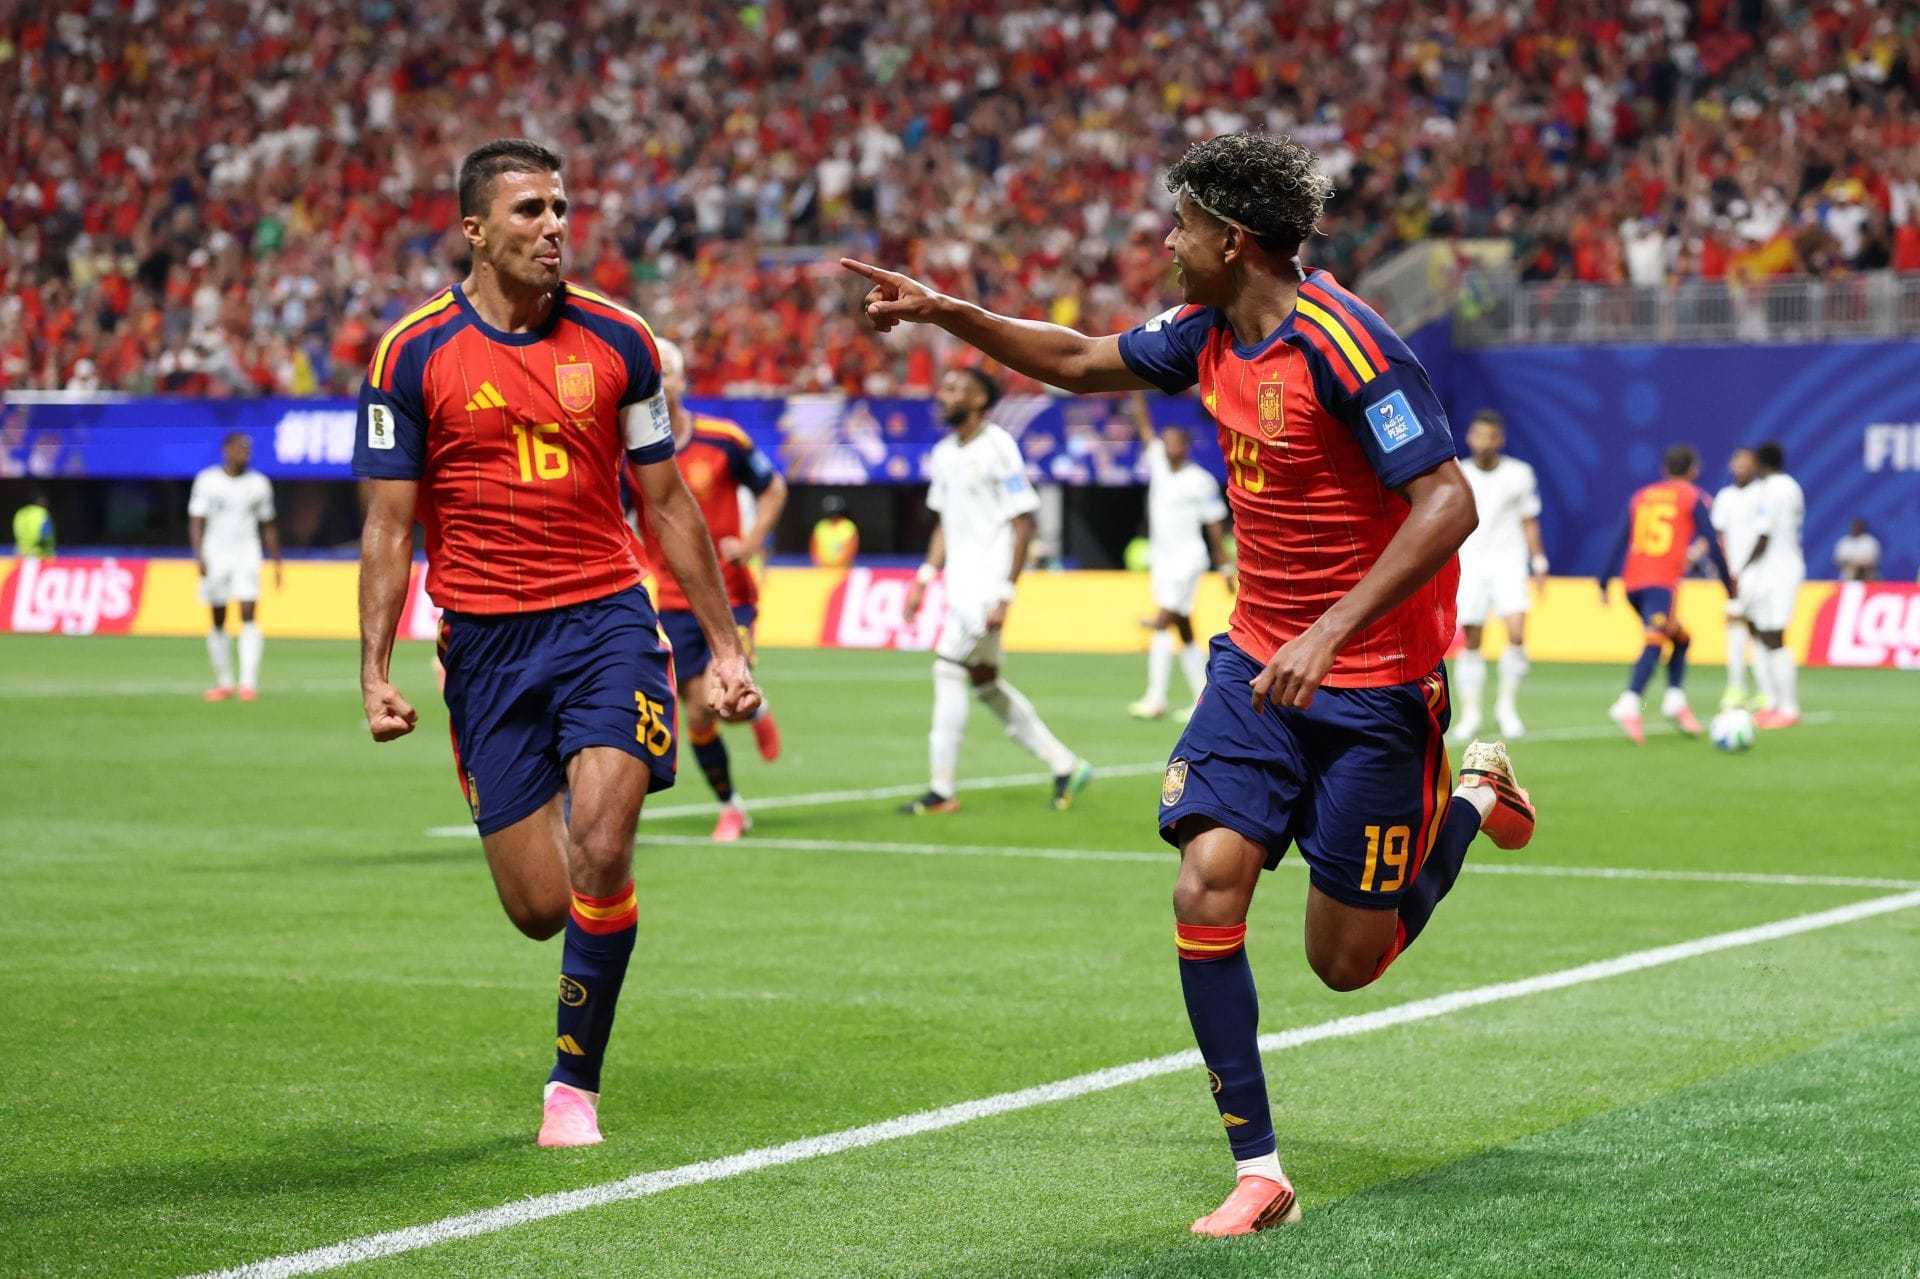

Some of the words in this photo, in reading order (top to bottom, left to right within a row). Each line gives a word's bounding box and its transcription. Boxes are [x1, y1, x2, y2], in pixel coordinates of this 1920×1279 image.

[512, 422, 569, 482] 16
[1387, 421, 1409, 438] PEACE
[1229, 430, 1264, 493] 19
[634, 690, 672, 757] 16
[1360, 825, 1410, 891] 19
